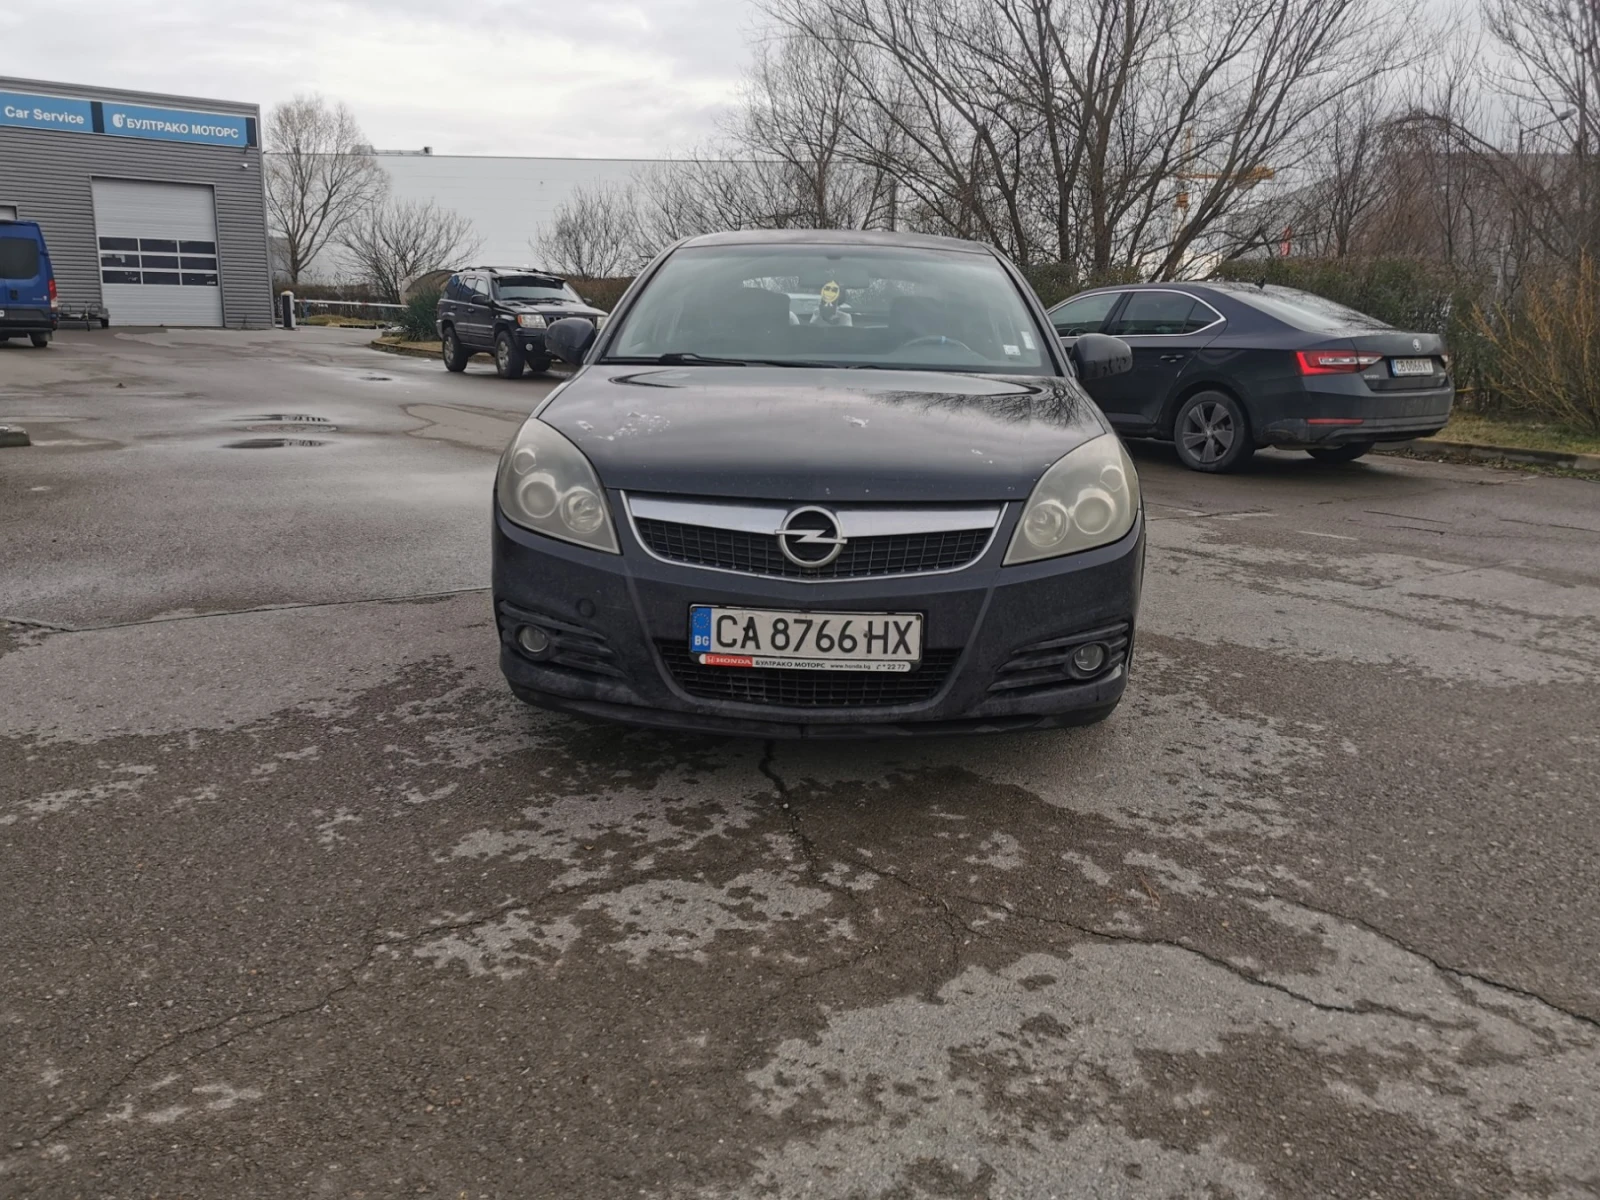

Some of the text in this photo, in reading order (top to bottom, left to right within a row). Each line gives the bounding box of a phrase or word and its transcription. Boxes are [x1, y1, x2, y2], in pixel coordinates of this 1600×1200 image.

[4, 105, 85, 125] Car Service
[126, 118, 239, 138] БУЛТРАКО МОТОРС
[694, 635, 710, 647] BG
[716, 614, 913, 655] CA 8766 HX
[715, 657, 751, 666] HONDA
[755, 660, 793, 668] БУЛТРАКО
